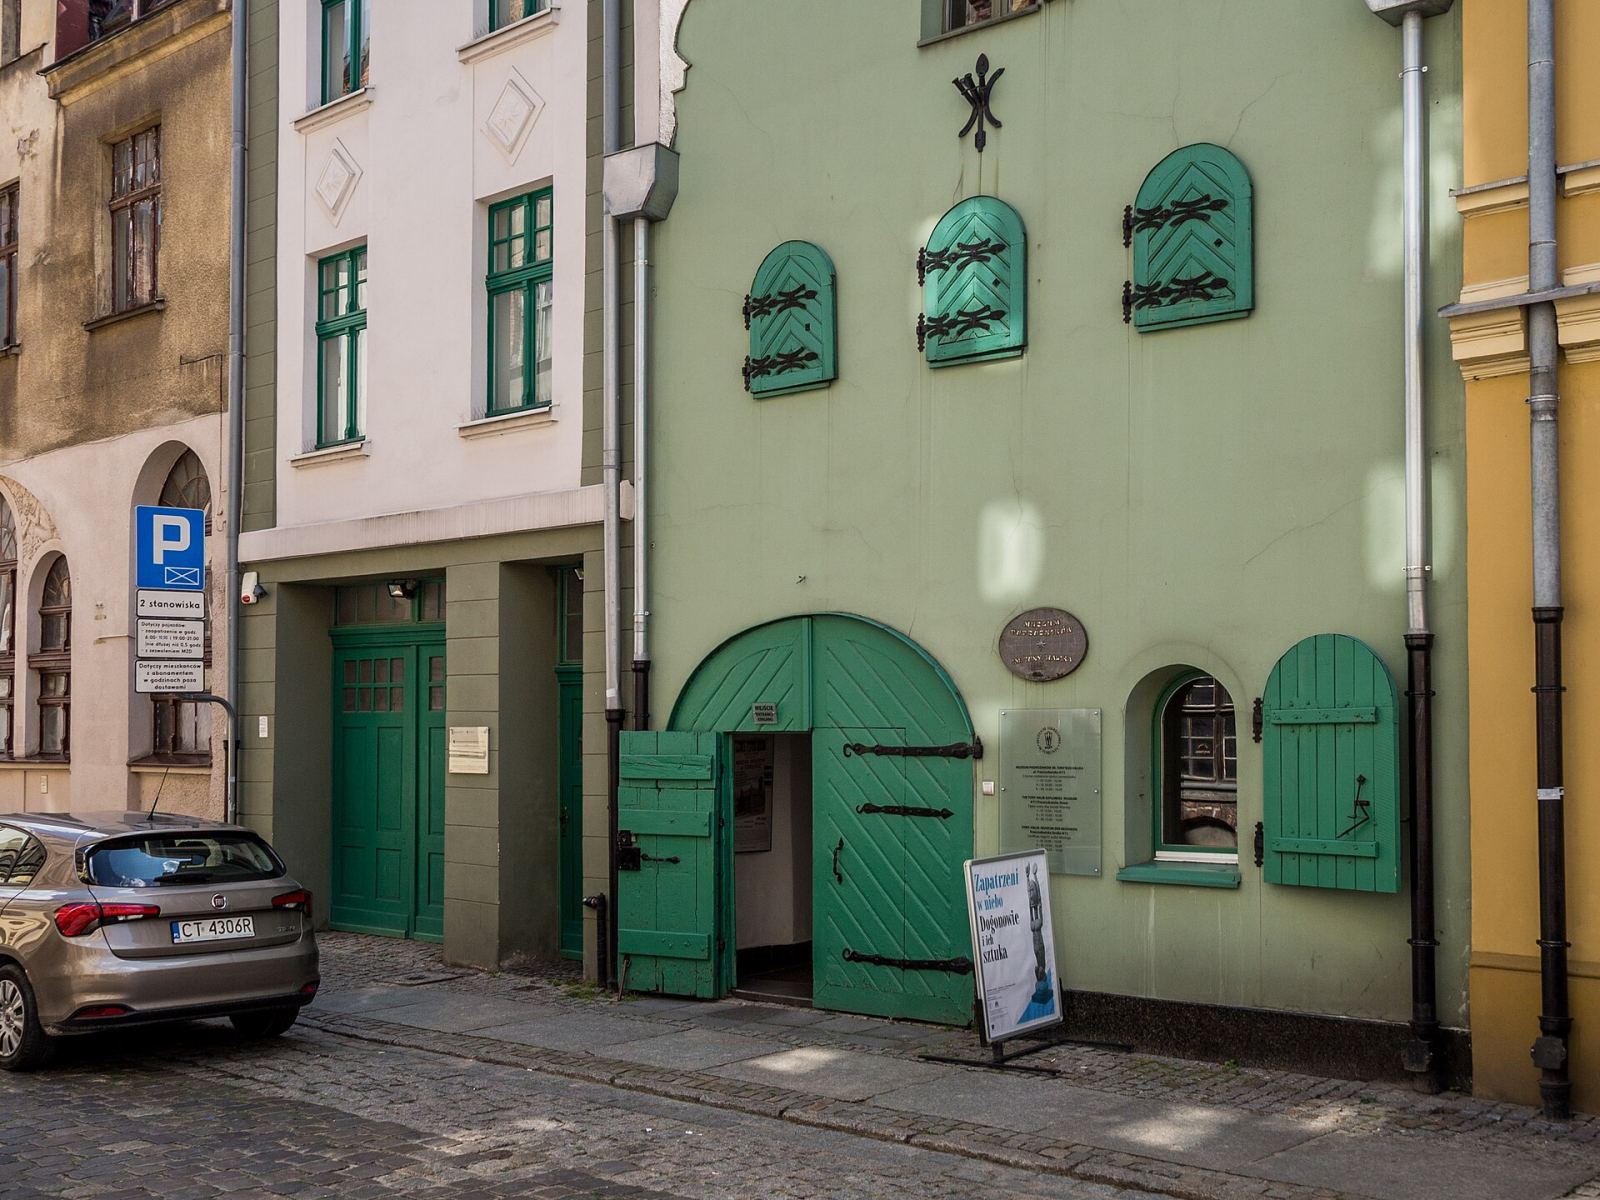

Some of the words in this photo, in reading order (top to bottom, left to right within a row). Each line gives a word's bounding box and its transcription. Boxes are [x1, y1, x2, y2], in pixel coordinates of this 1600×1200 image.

[153, 514, 190, 564] P
[149, 600, 200, 608] stanowiska
[974, 868, 1019, 895] Zapatrzeni
[977, 900, 983, 911] w
[984, 894, 1004, 910] niebo
[182, 922, 202, 938] CT
[209, 918, 252, 935] 4306R
[979, 910, 1020, 934] Dogonowie
[985, 934, 994, 945] ich
[983, 944, 1008, 963] sztuka
